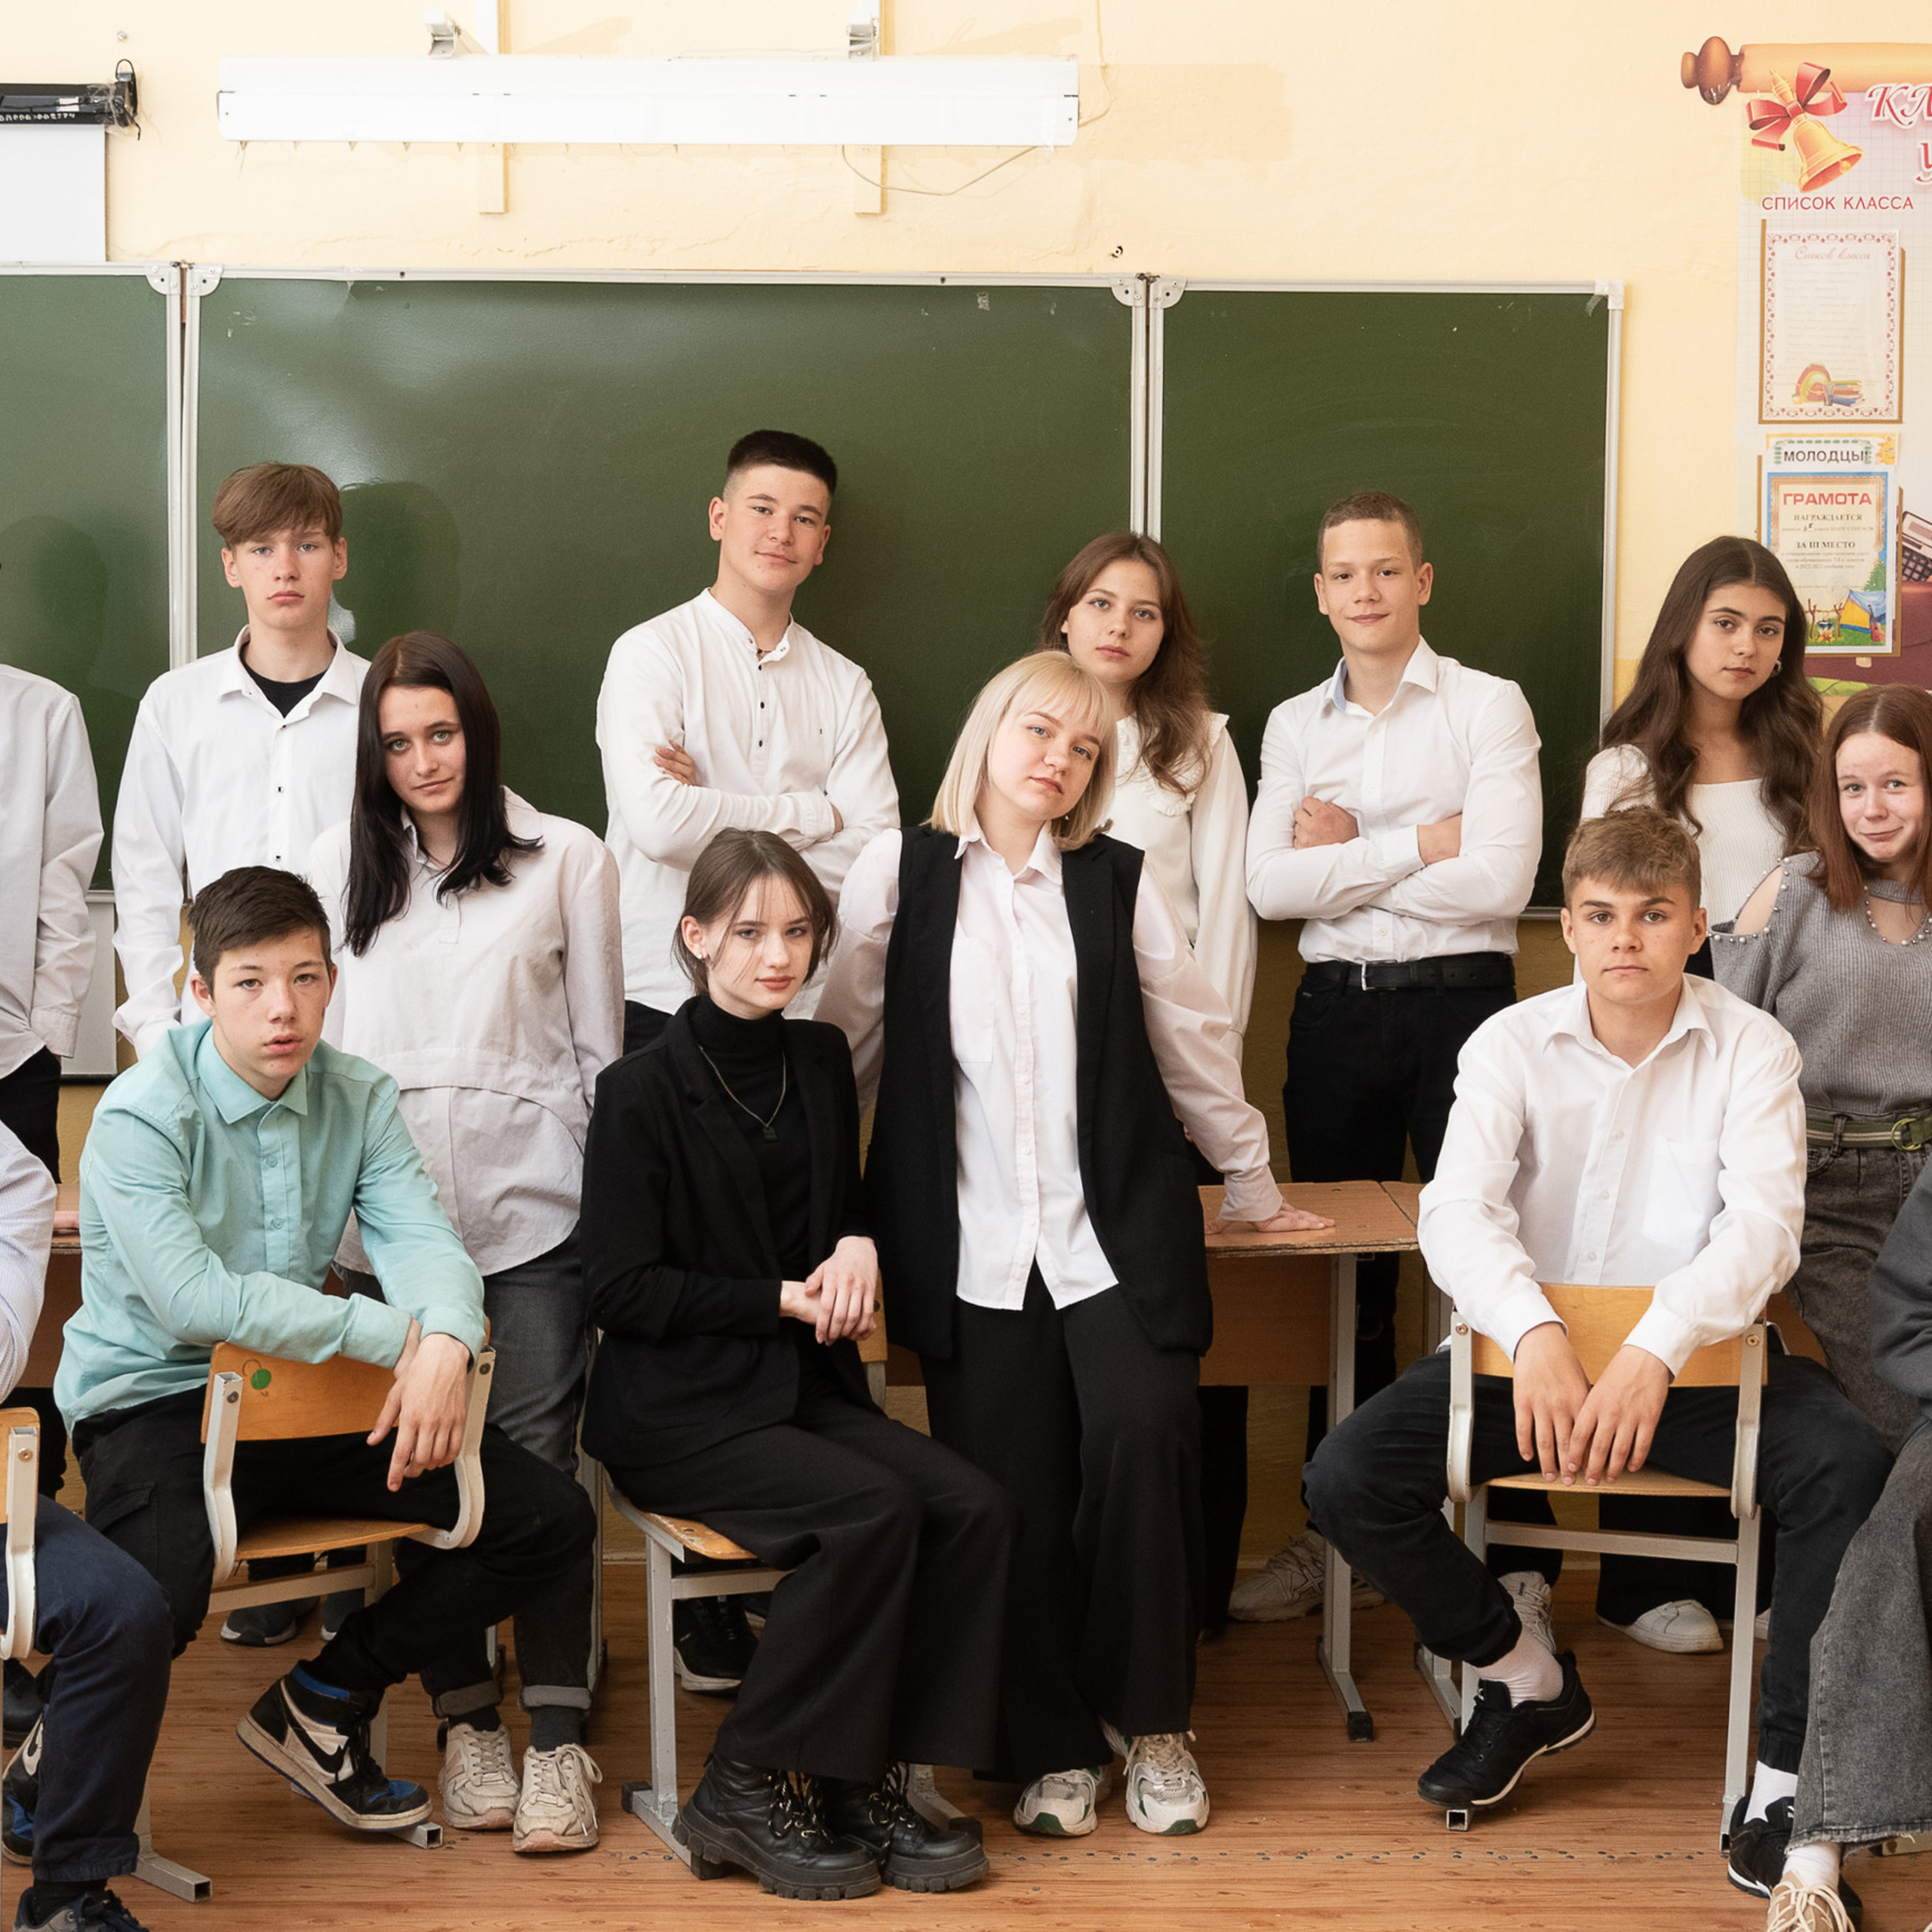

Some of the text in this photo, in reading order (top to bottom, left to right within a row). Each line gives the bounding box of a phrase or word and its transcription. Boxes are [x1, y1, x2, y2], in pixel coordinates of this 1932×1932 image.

[1761, 196, 1914, 211] СПИСОК КЛАССА
[1783, 492, 1872, 506] ГРАМОТА
